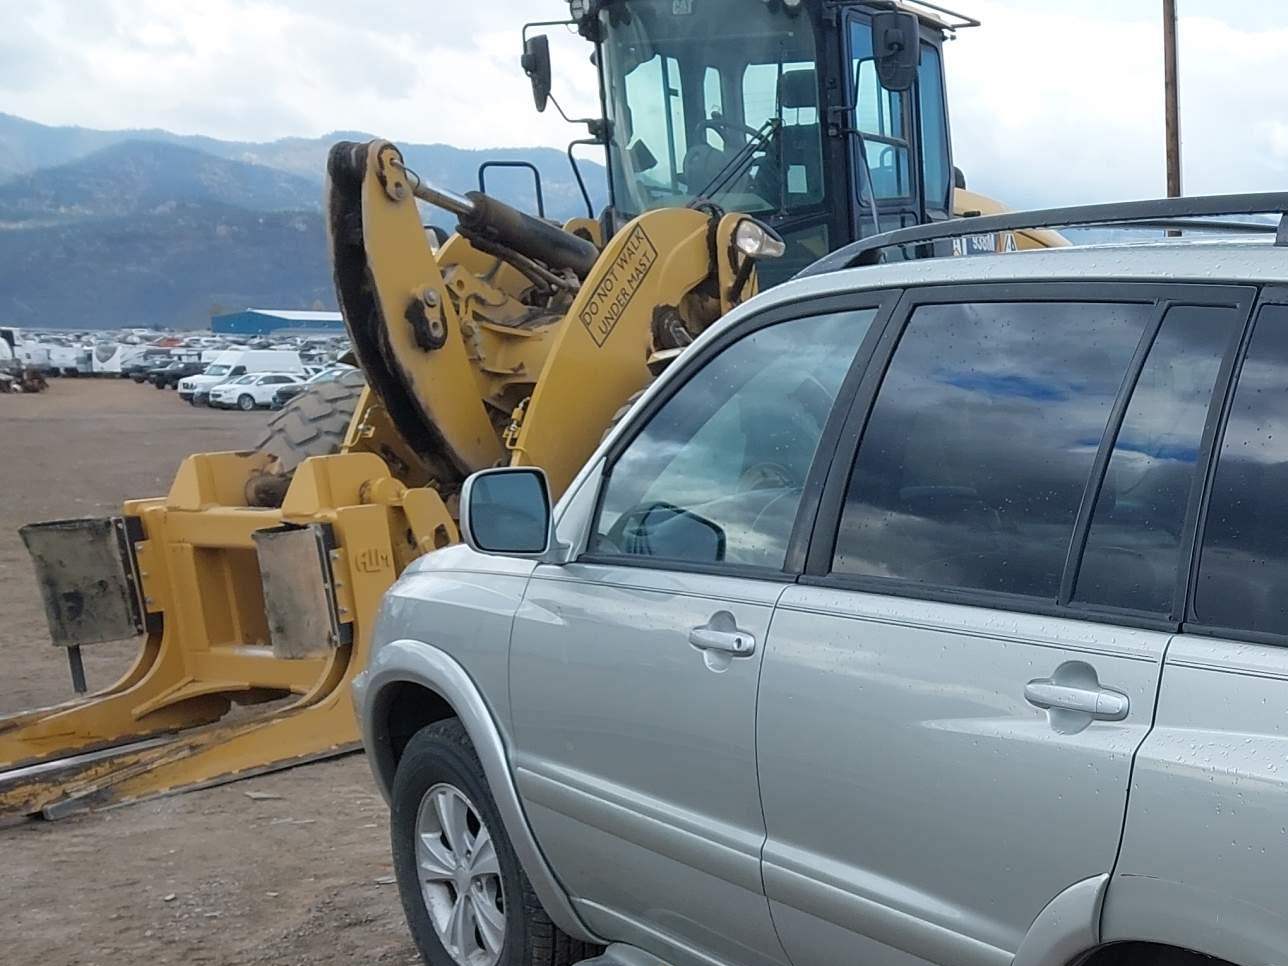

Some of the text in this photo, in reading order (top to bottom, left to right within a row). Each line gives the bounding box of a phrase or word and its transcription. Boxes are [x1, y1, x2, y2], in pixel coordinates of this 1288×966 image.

[582, 228, 645, 326] DO NOT WALK
[598, 251, 651, 334] UNDER MAST
